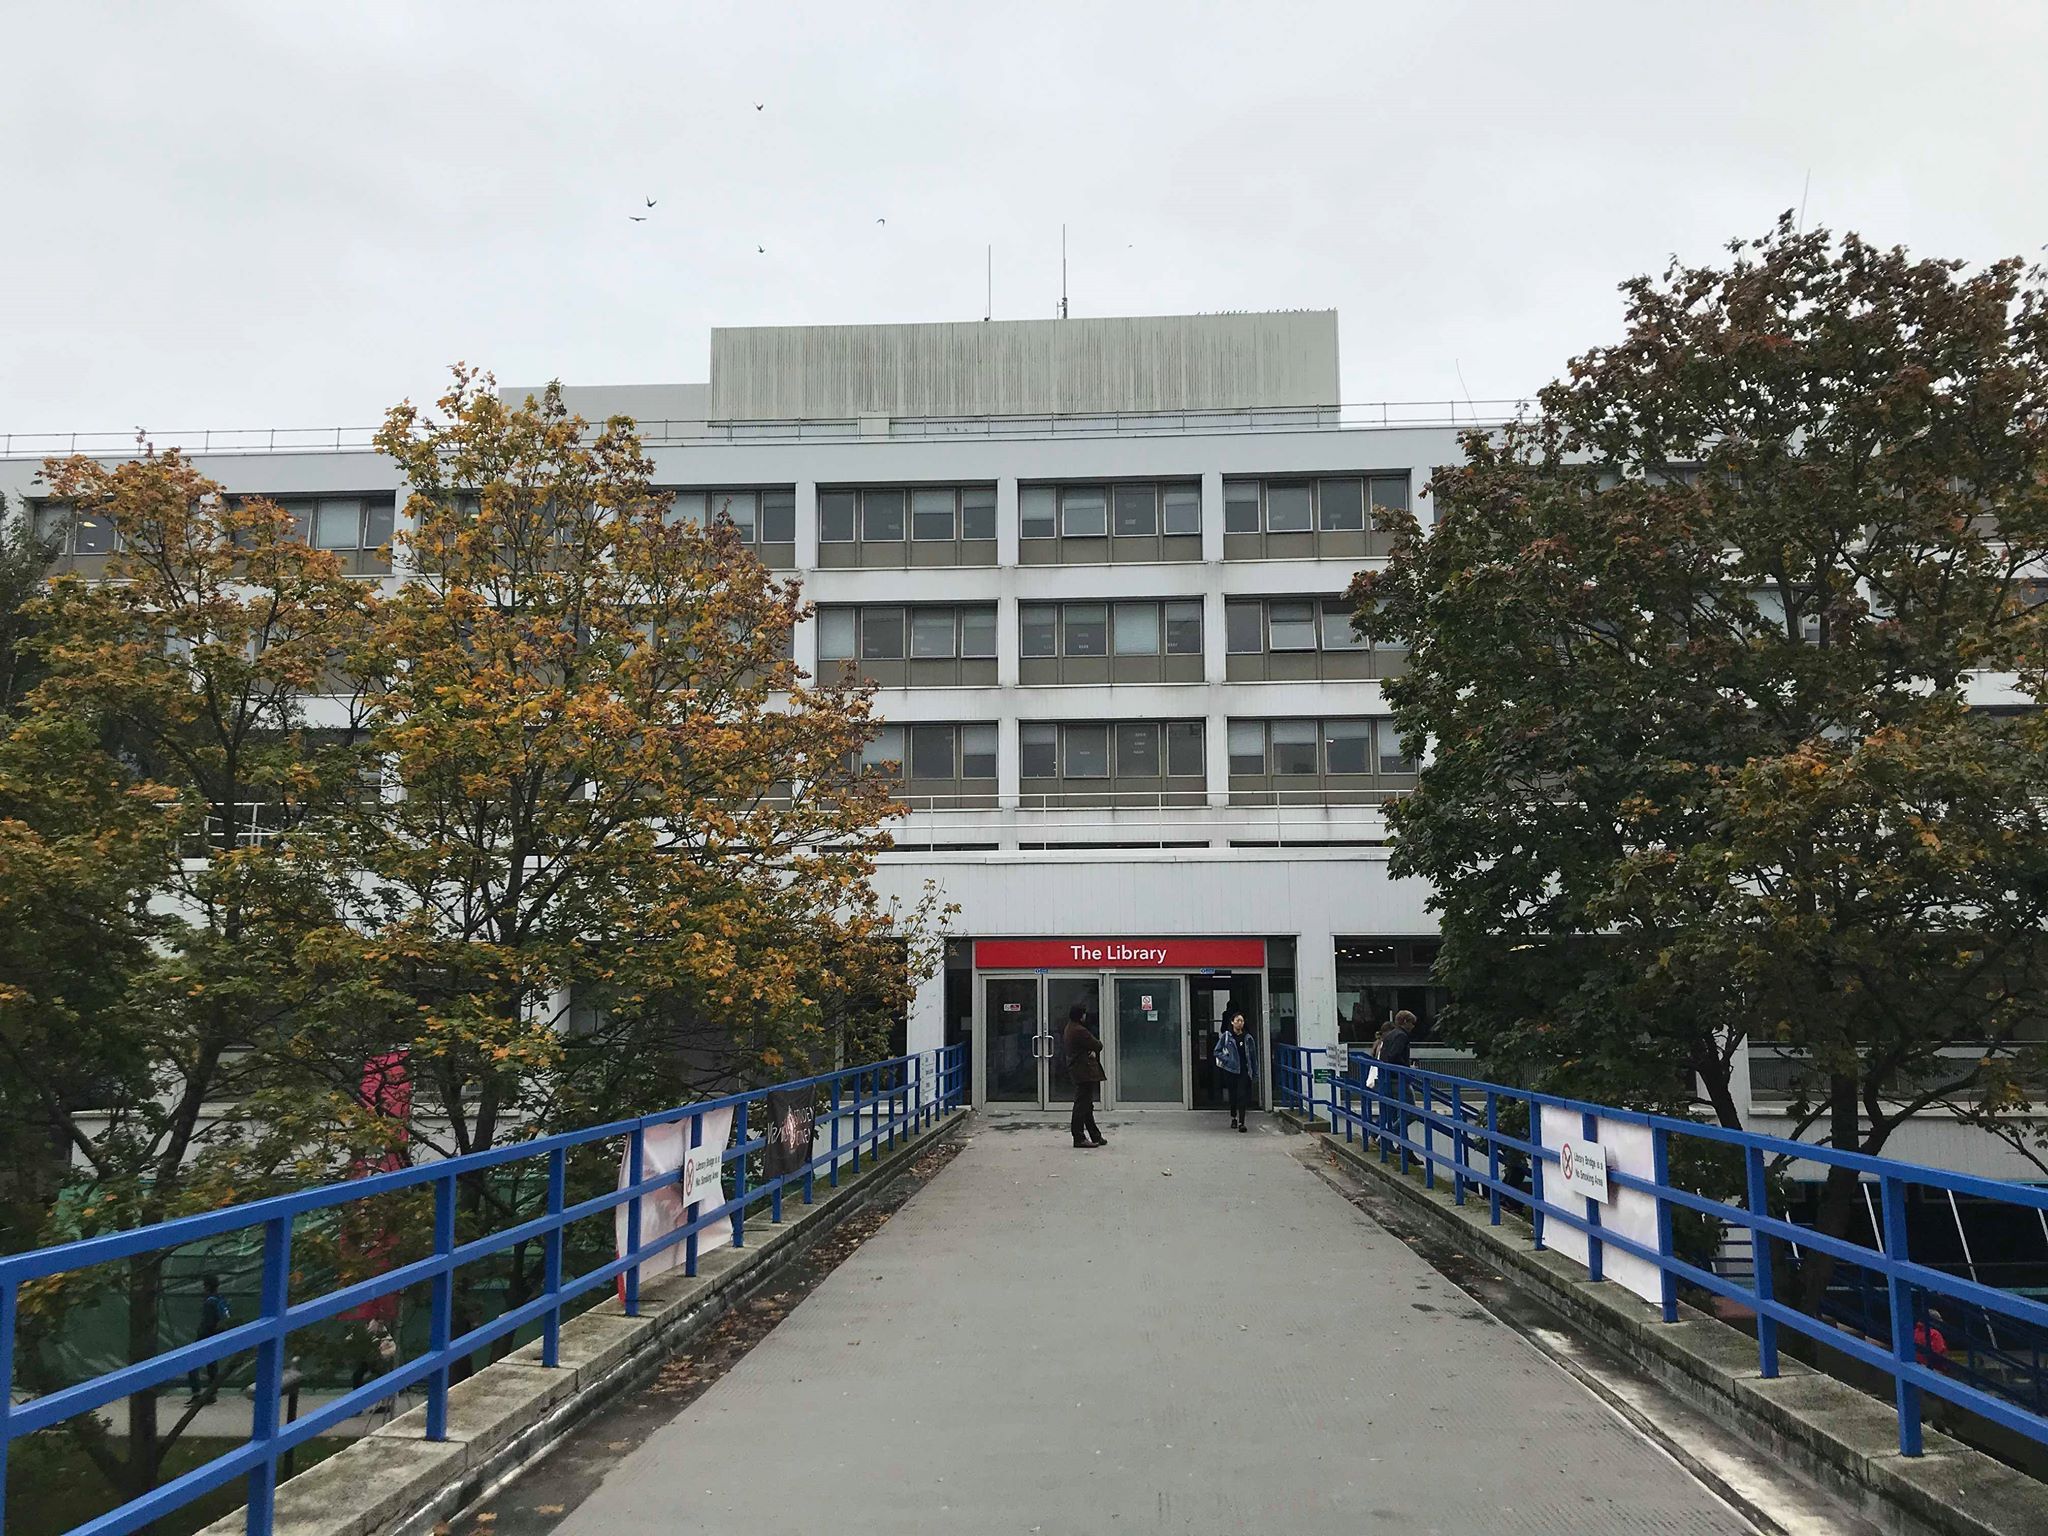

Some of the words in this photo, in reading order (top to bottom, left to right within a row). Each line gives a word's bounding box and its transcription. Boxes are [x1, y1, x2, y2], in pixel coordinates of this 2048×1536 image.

[1070, 944, 1102, 960] The
[1107, 944, 1167, 964] Library
[1574, 1152, 1584, 1166] Library
[1584, 1155, 1595, 1169] Bridge
[1580, 1169, 1594, 1186] Smoking
[1594, 1175, 1603, 1187] Area
